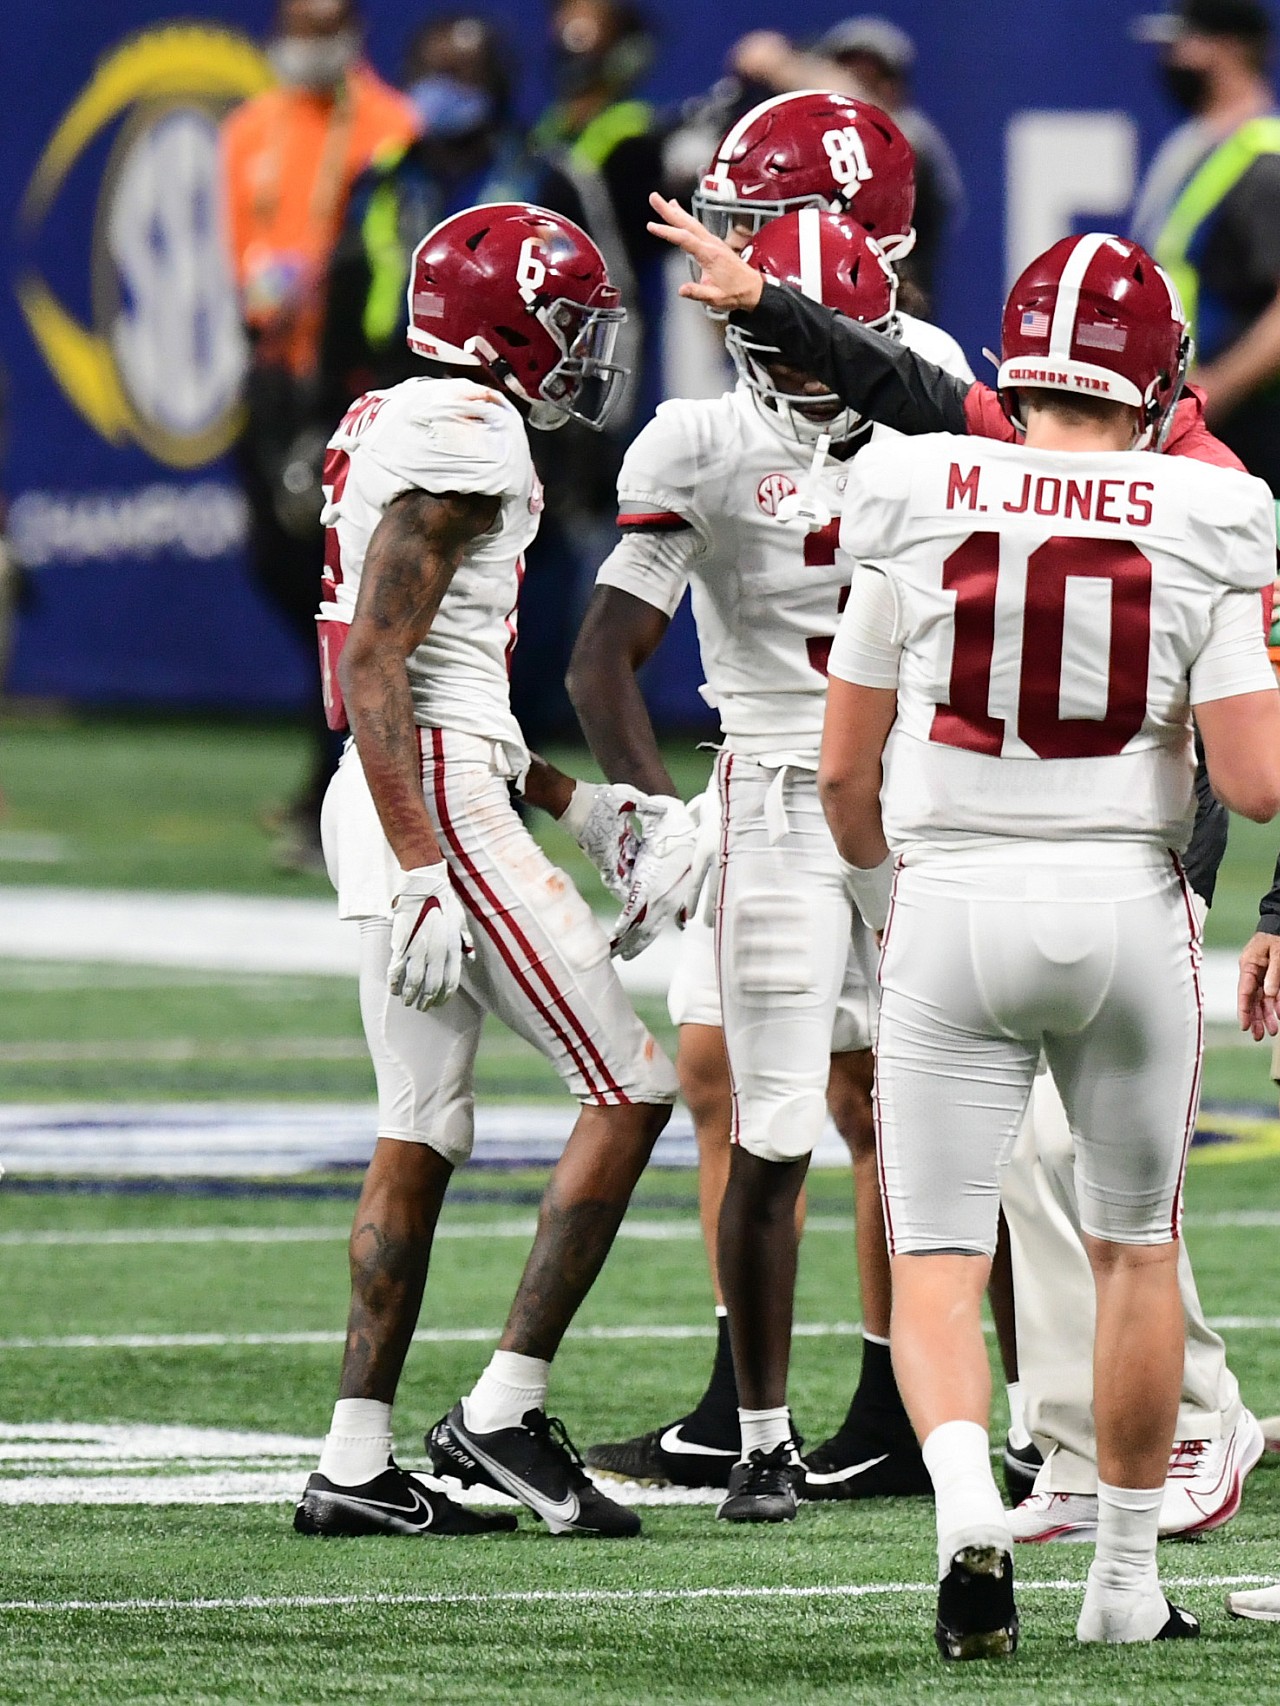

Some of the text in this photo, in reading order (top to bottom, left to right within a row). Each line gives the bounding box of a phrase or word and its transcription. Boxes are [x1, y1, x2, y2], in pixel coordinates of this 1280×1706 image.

[822, 126, 873, 184] 81
[516, 237, 546, 290] 6
[1009, 368, 1110, 392] CRIMSON TIDE
[946, 462, 1154, 527] M. JONES
[929, 531, 1152, 760] 10
